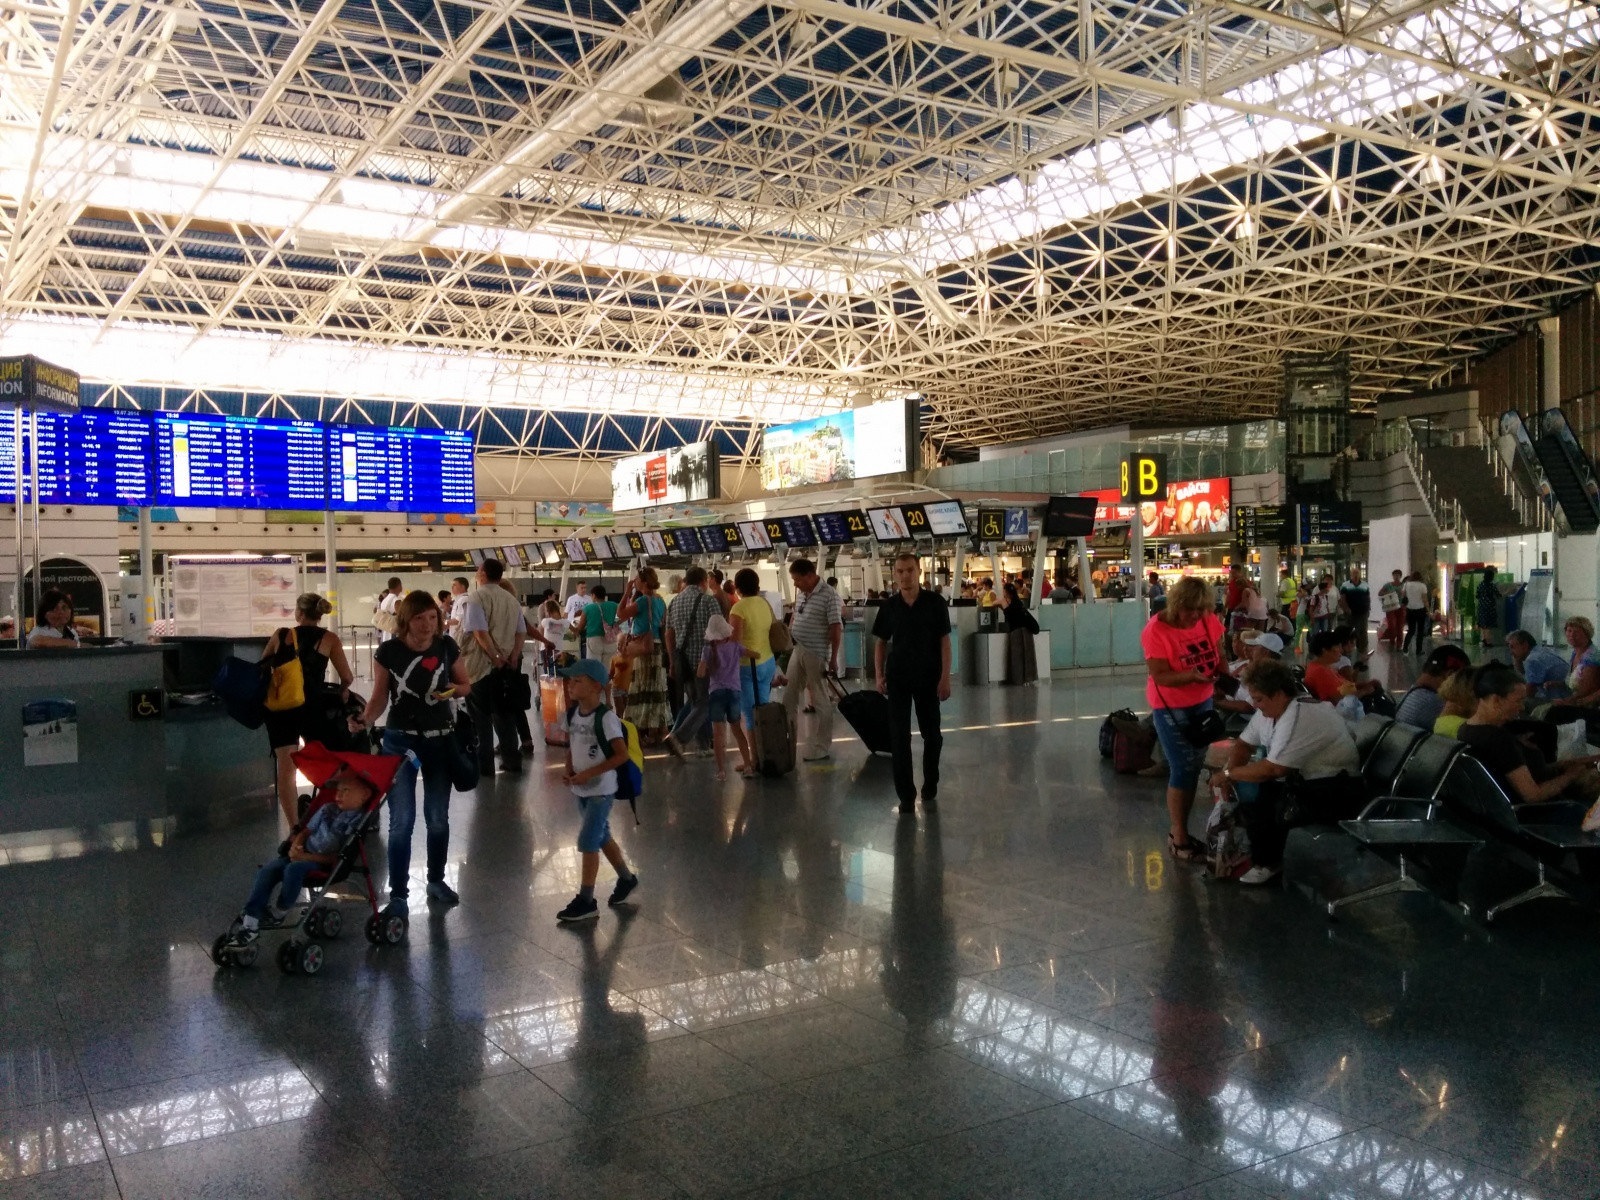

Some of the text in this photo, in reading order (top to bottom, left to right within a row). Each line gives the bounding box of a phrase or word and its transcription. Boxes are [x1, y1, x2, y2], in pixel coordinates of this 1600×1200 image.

[36, 382, 78, 407] INFORMATION
[1121, 460, 1128, 497] B
[1138, 458, 1159, 496] B
[848, 516, 865, 531] 21
[908, 510, 924, 526] 20
[725, 528, 737, 541] 23
[768, 524, 782, 537] 22
[630, 538, 641, 549] 25
[664, 534, 674, 546] 24
